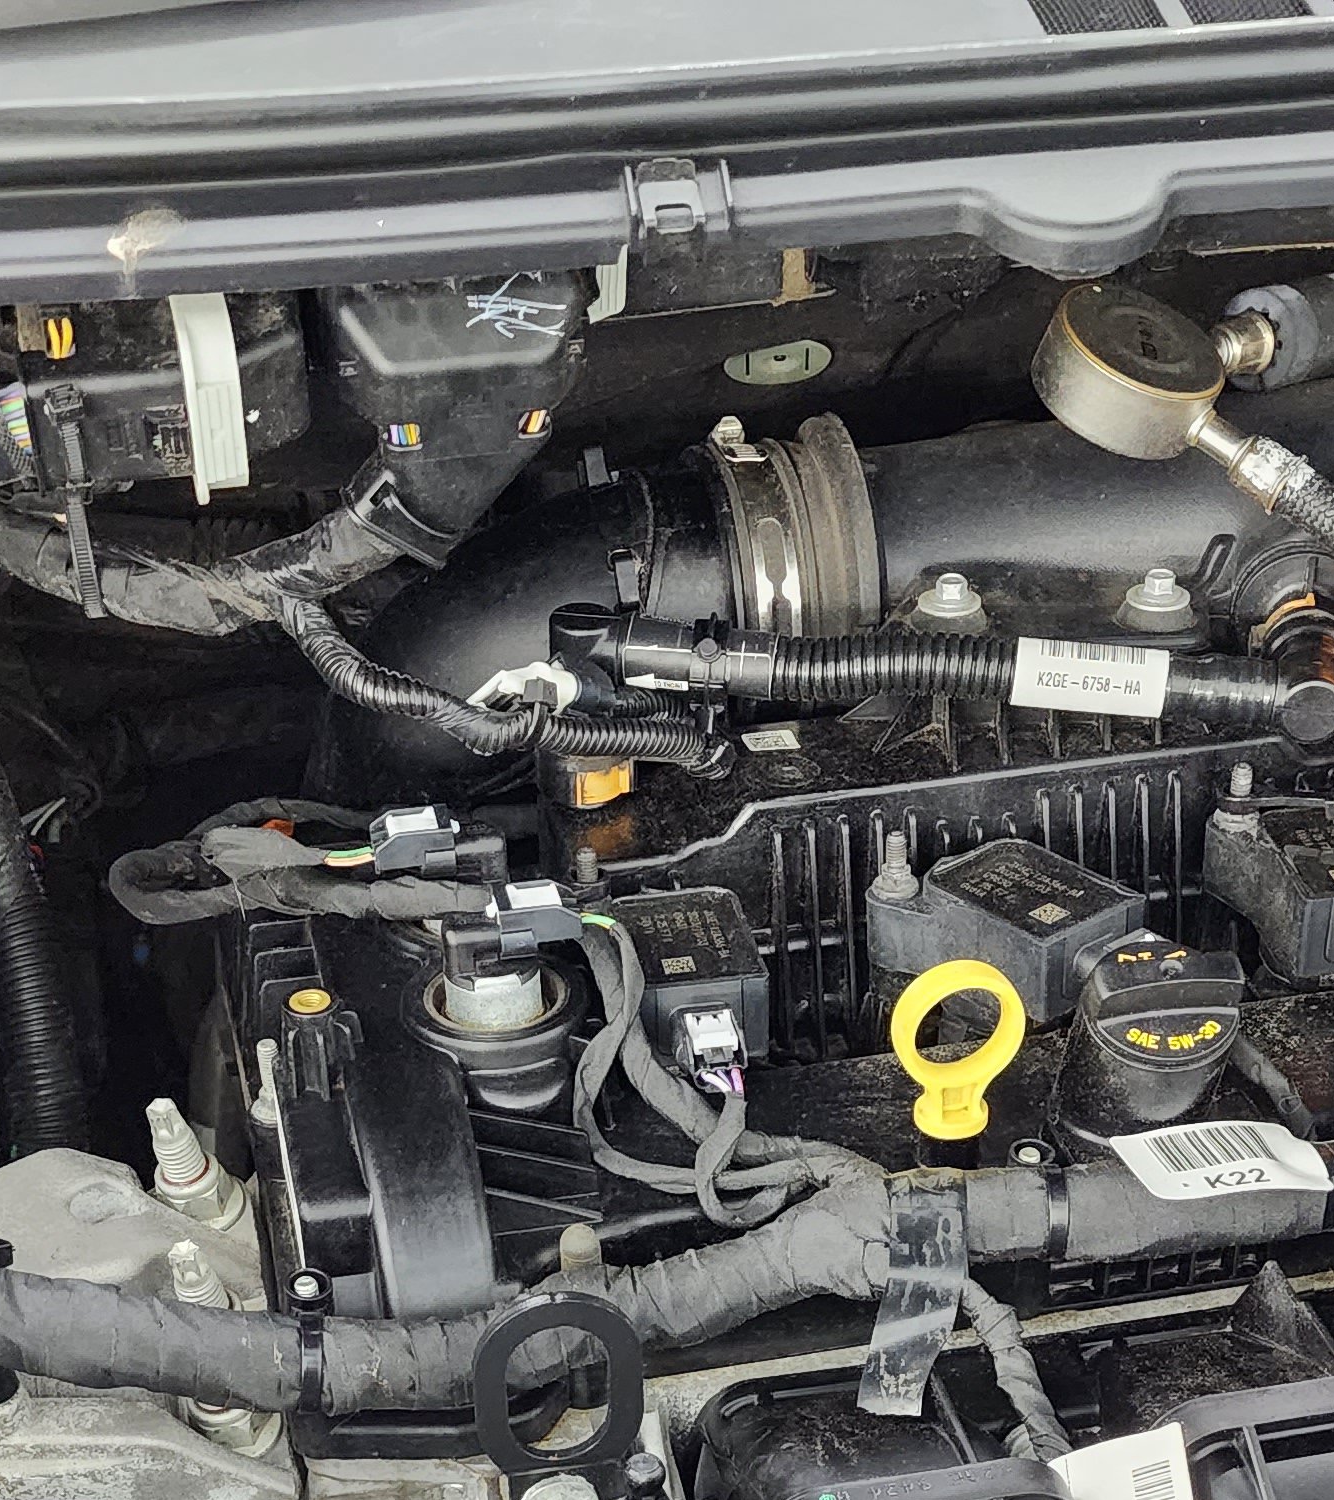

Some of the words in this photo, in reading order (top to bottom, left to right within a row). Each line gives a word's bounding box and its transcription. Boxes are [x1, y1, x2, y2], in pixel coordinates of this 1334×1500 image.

[1126, 1028, 1160, 1049] SAE
[1167, 1020, 1222, 1050] 5W-30
[1203, 1168, 1271, 1189] K22
